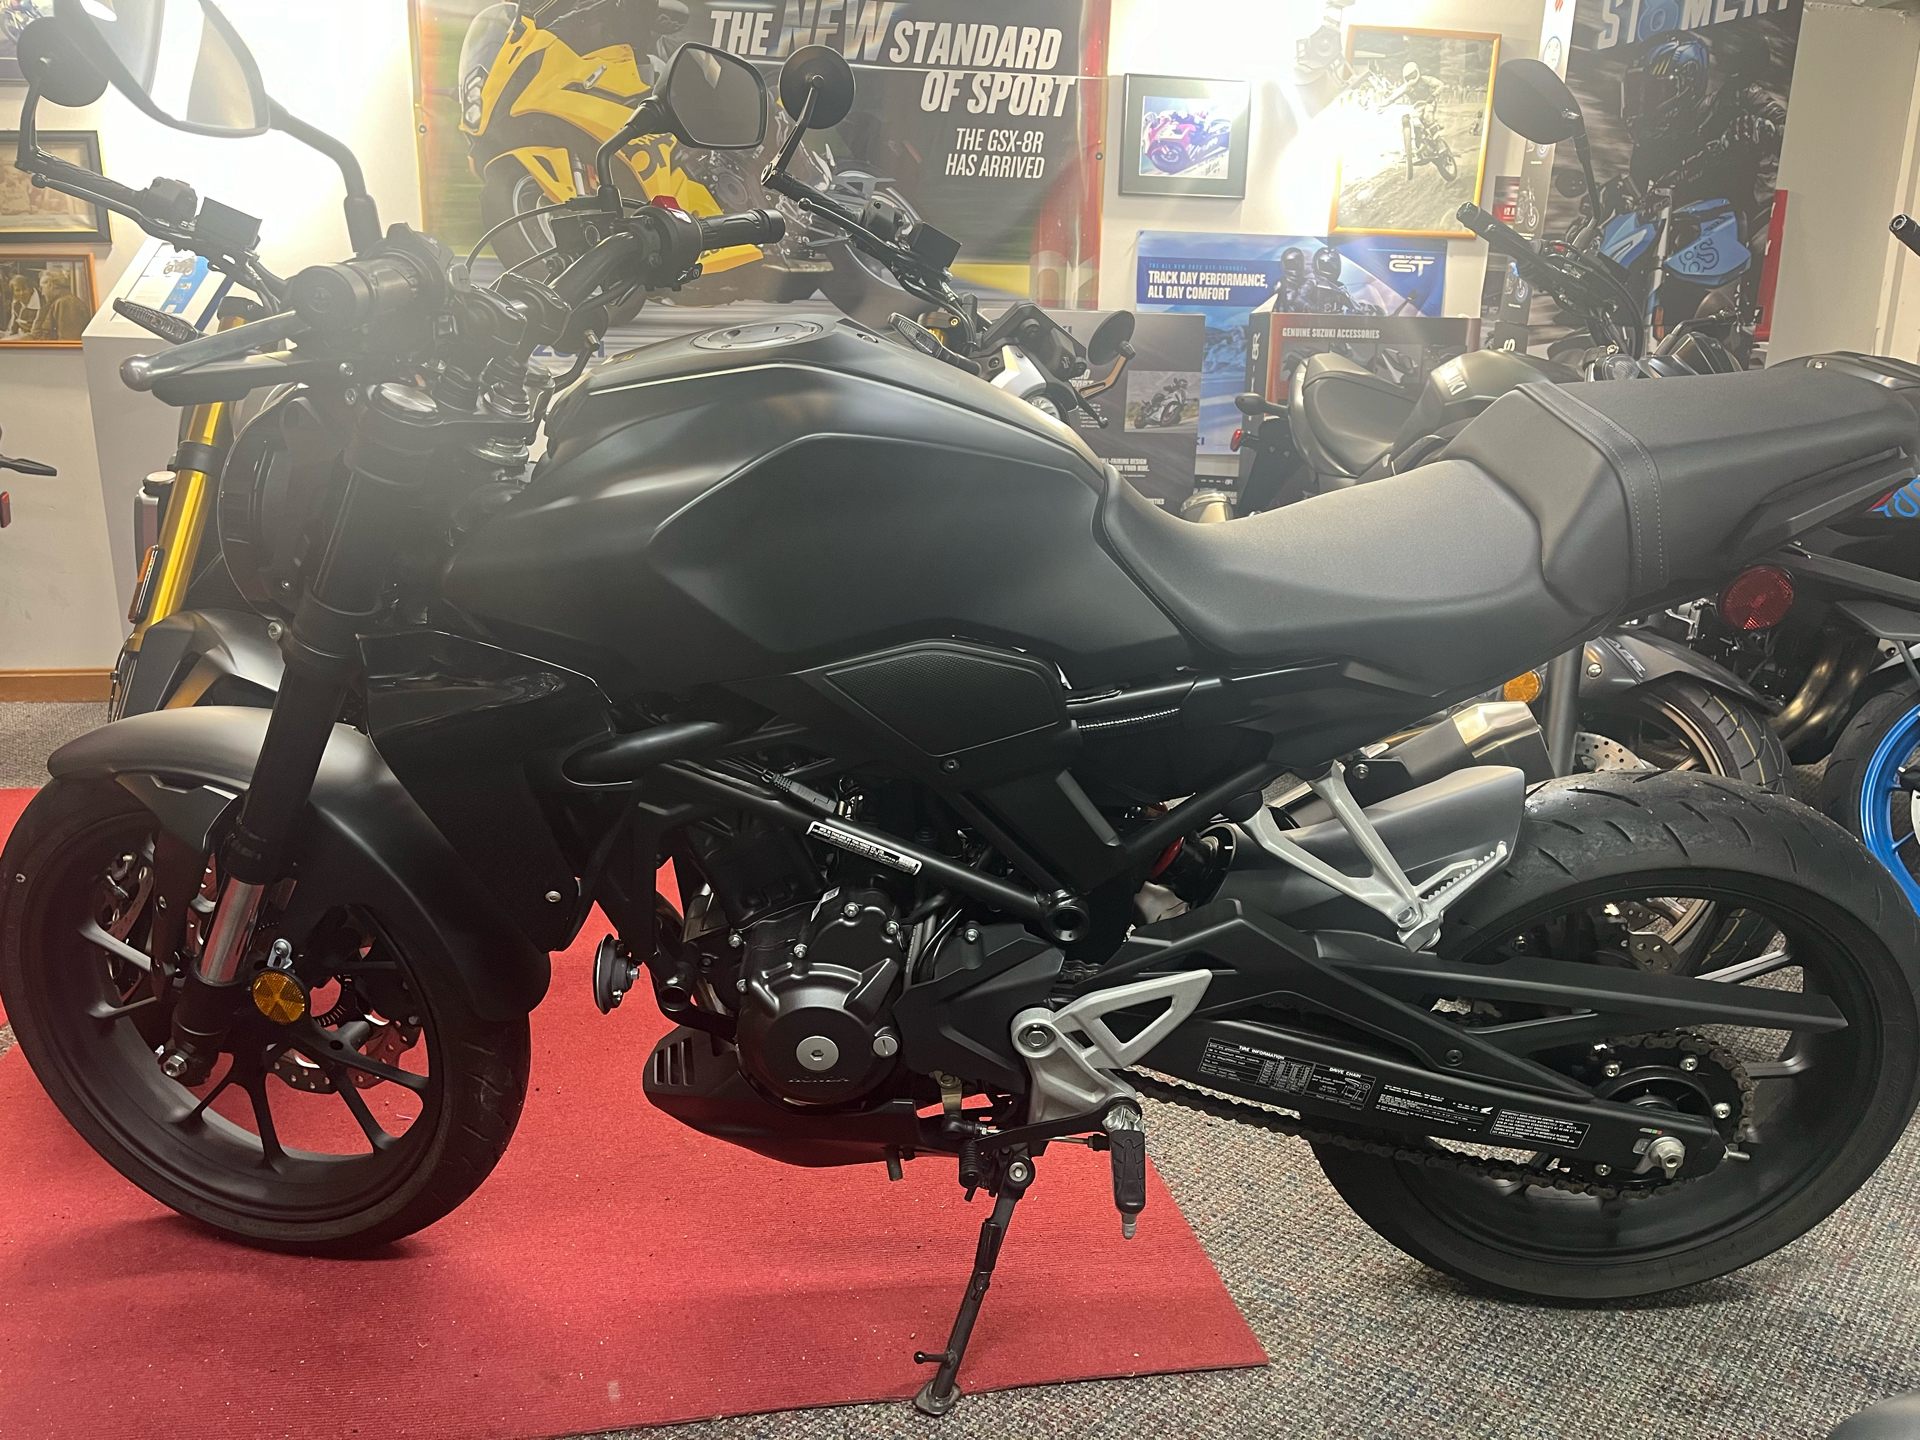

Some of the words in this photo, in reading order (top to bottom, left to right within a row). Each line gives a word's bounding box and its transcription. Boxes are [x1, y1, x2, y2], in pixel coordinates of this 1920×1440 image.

[710, 11, 773, 56] THE
[776, 0, 898, 62] NEW
[889, 20, 1063, 71] STANDARD
[920, 71, 962, 113] OF
[966, 73, 1077, 118] SPORT
[956, 127, 983, 152] THE
[987, 128, 1045, 154] GSX-8R
[945, 153, 977, 177] HAS
[979, 154, 1046, 179] ARRIVED
[1148, 270, 1178, 284] TRACK
[1180, 272, 1199, 285] DAY
[1199, 272, 1268, 289] PERFORMANCE,
[1147, 286, 1164, 298] ALL
[1166, 286, 1185, 299] DAY
[1186, 287, 1231, 301] COMFORT
[1282, 328, 1311, 337] GENUINE
[1311, 328, 1336, 338] SUZUKI
[1336, 329, 1381, 339] ACCESSORIES
[1251, 1048, 1285, 1060] INFORMATION
[1329, 1067, 1345, 1076] DRIVE
[1345, 1070, 1362, 1079] CHAIN
